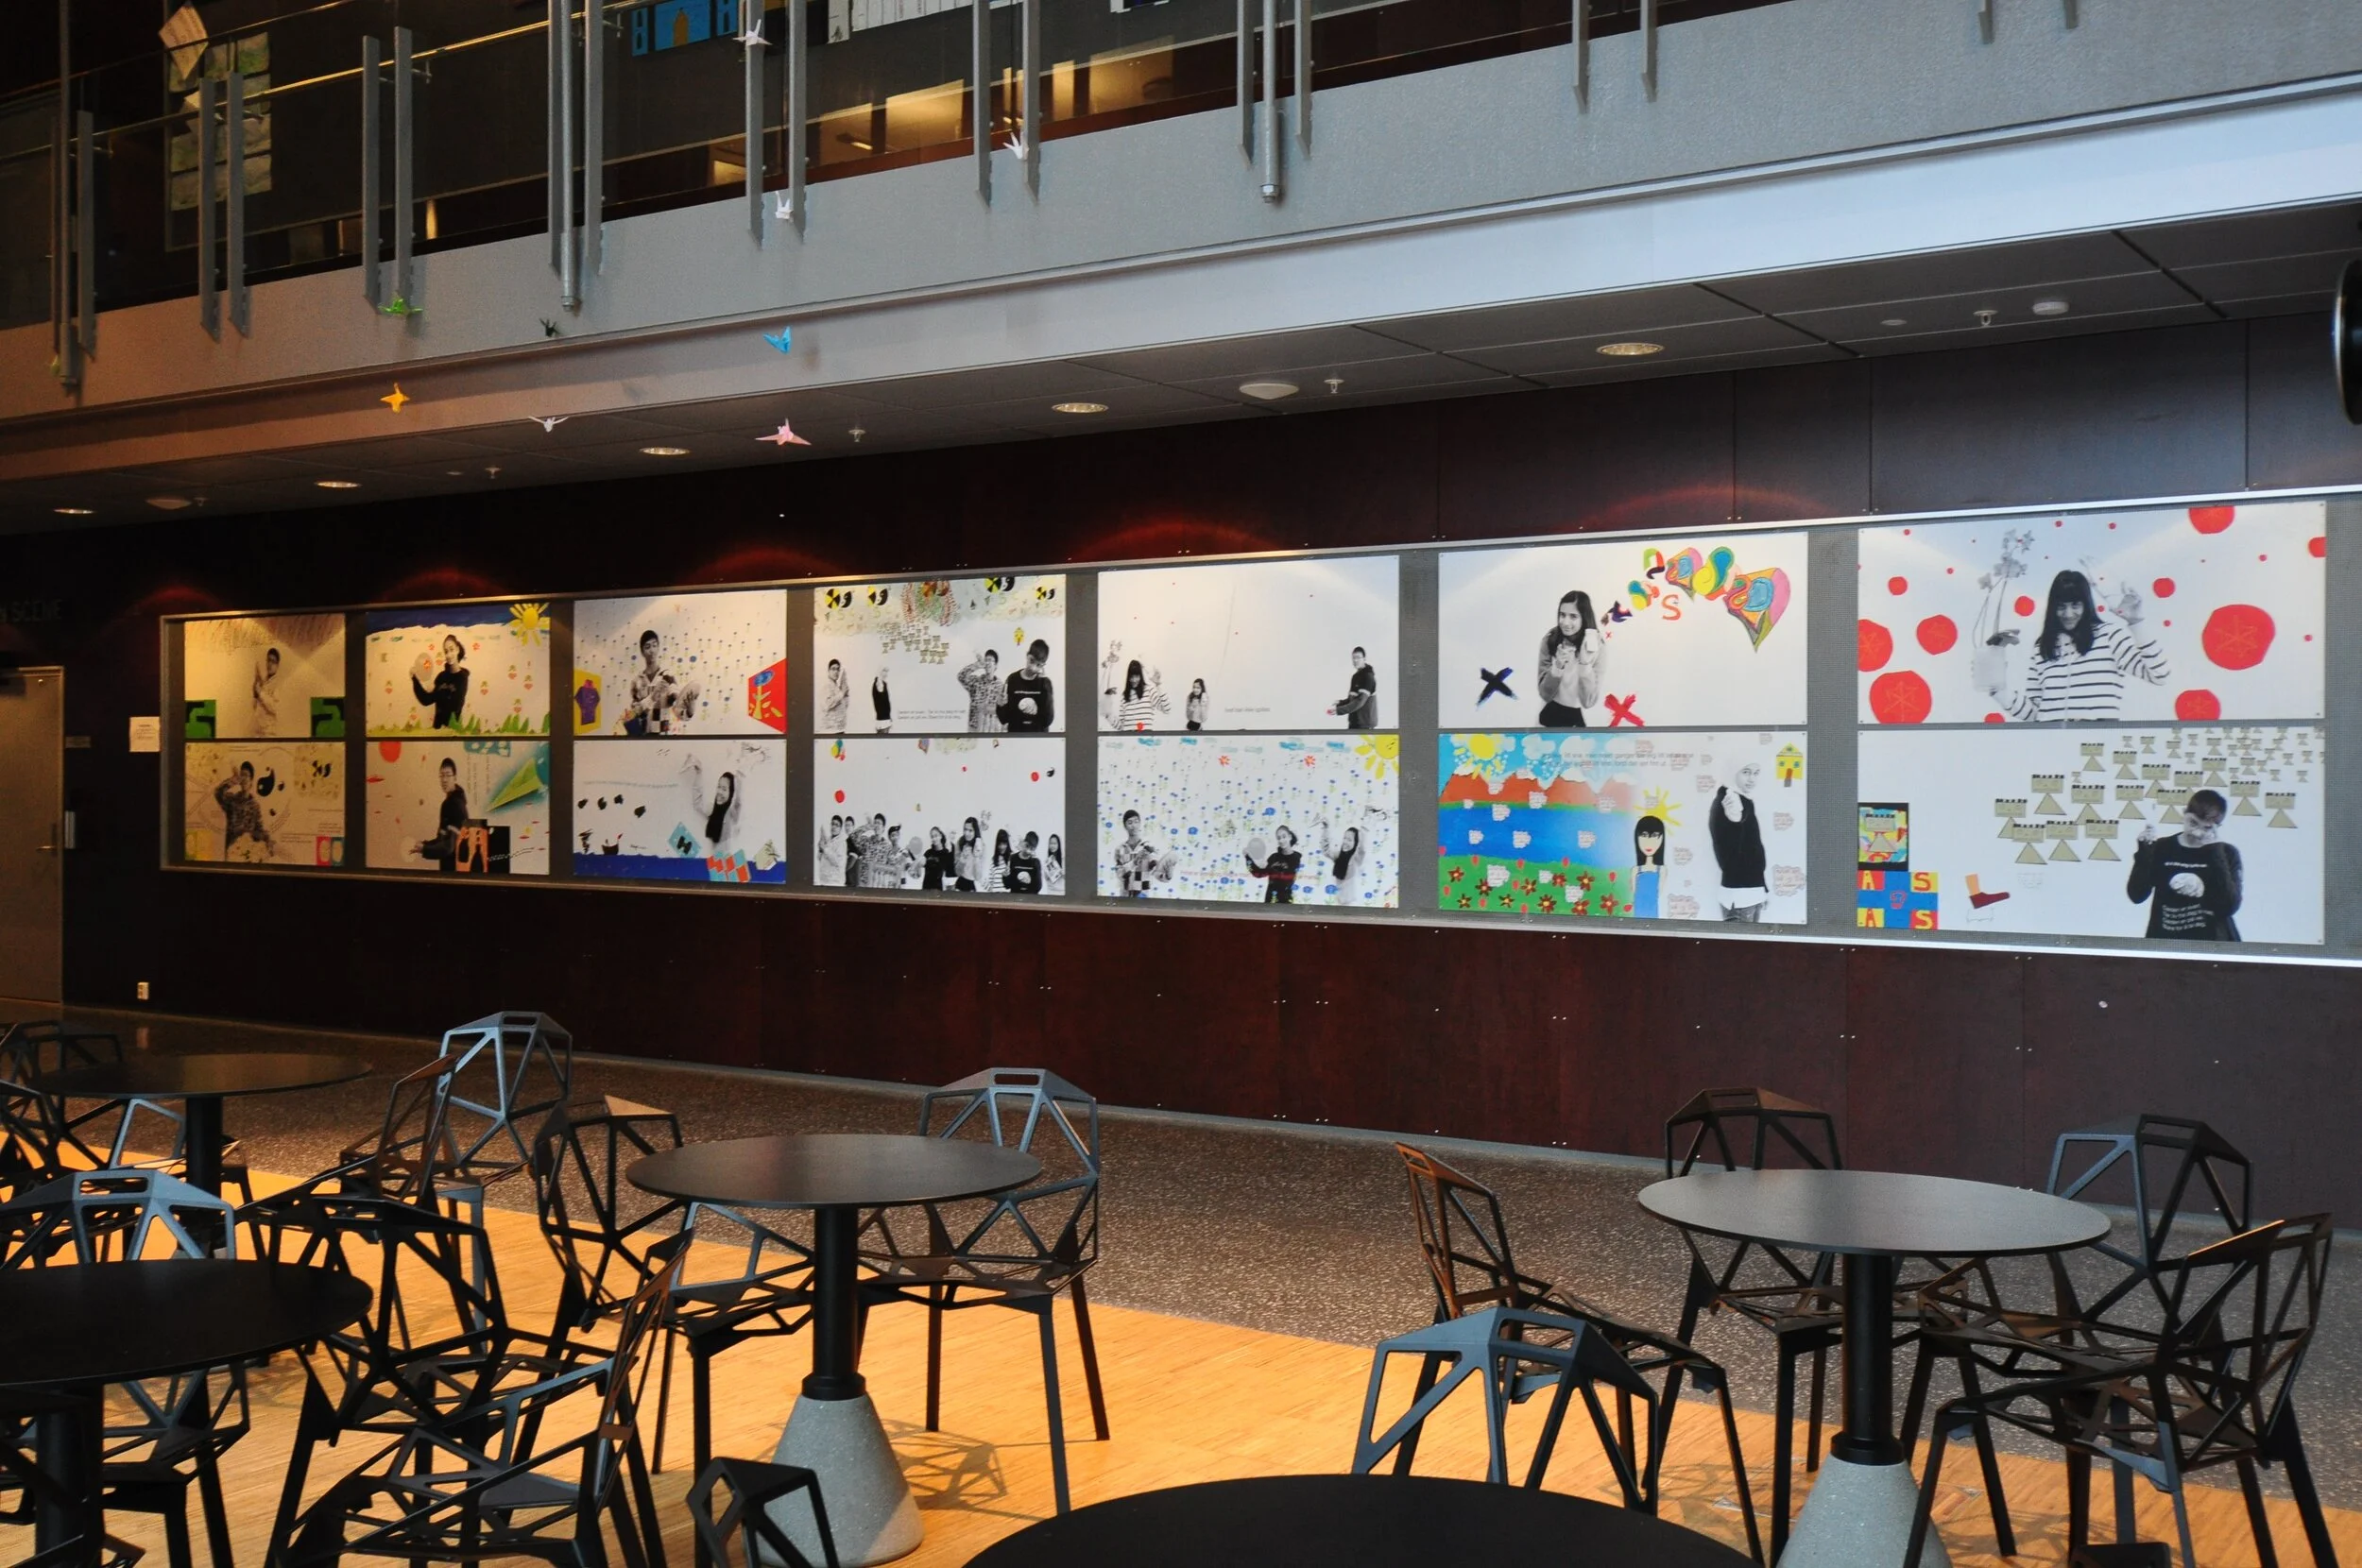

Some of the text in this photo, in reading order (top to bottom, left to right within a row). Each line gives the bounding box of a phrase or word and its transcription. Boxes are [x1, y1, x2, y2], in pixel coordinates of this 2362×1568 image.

[1863, 871, 1931, 891] A S
[1865, 909, 1932, 929] A S
